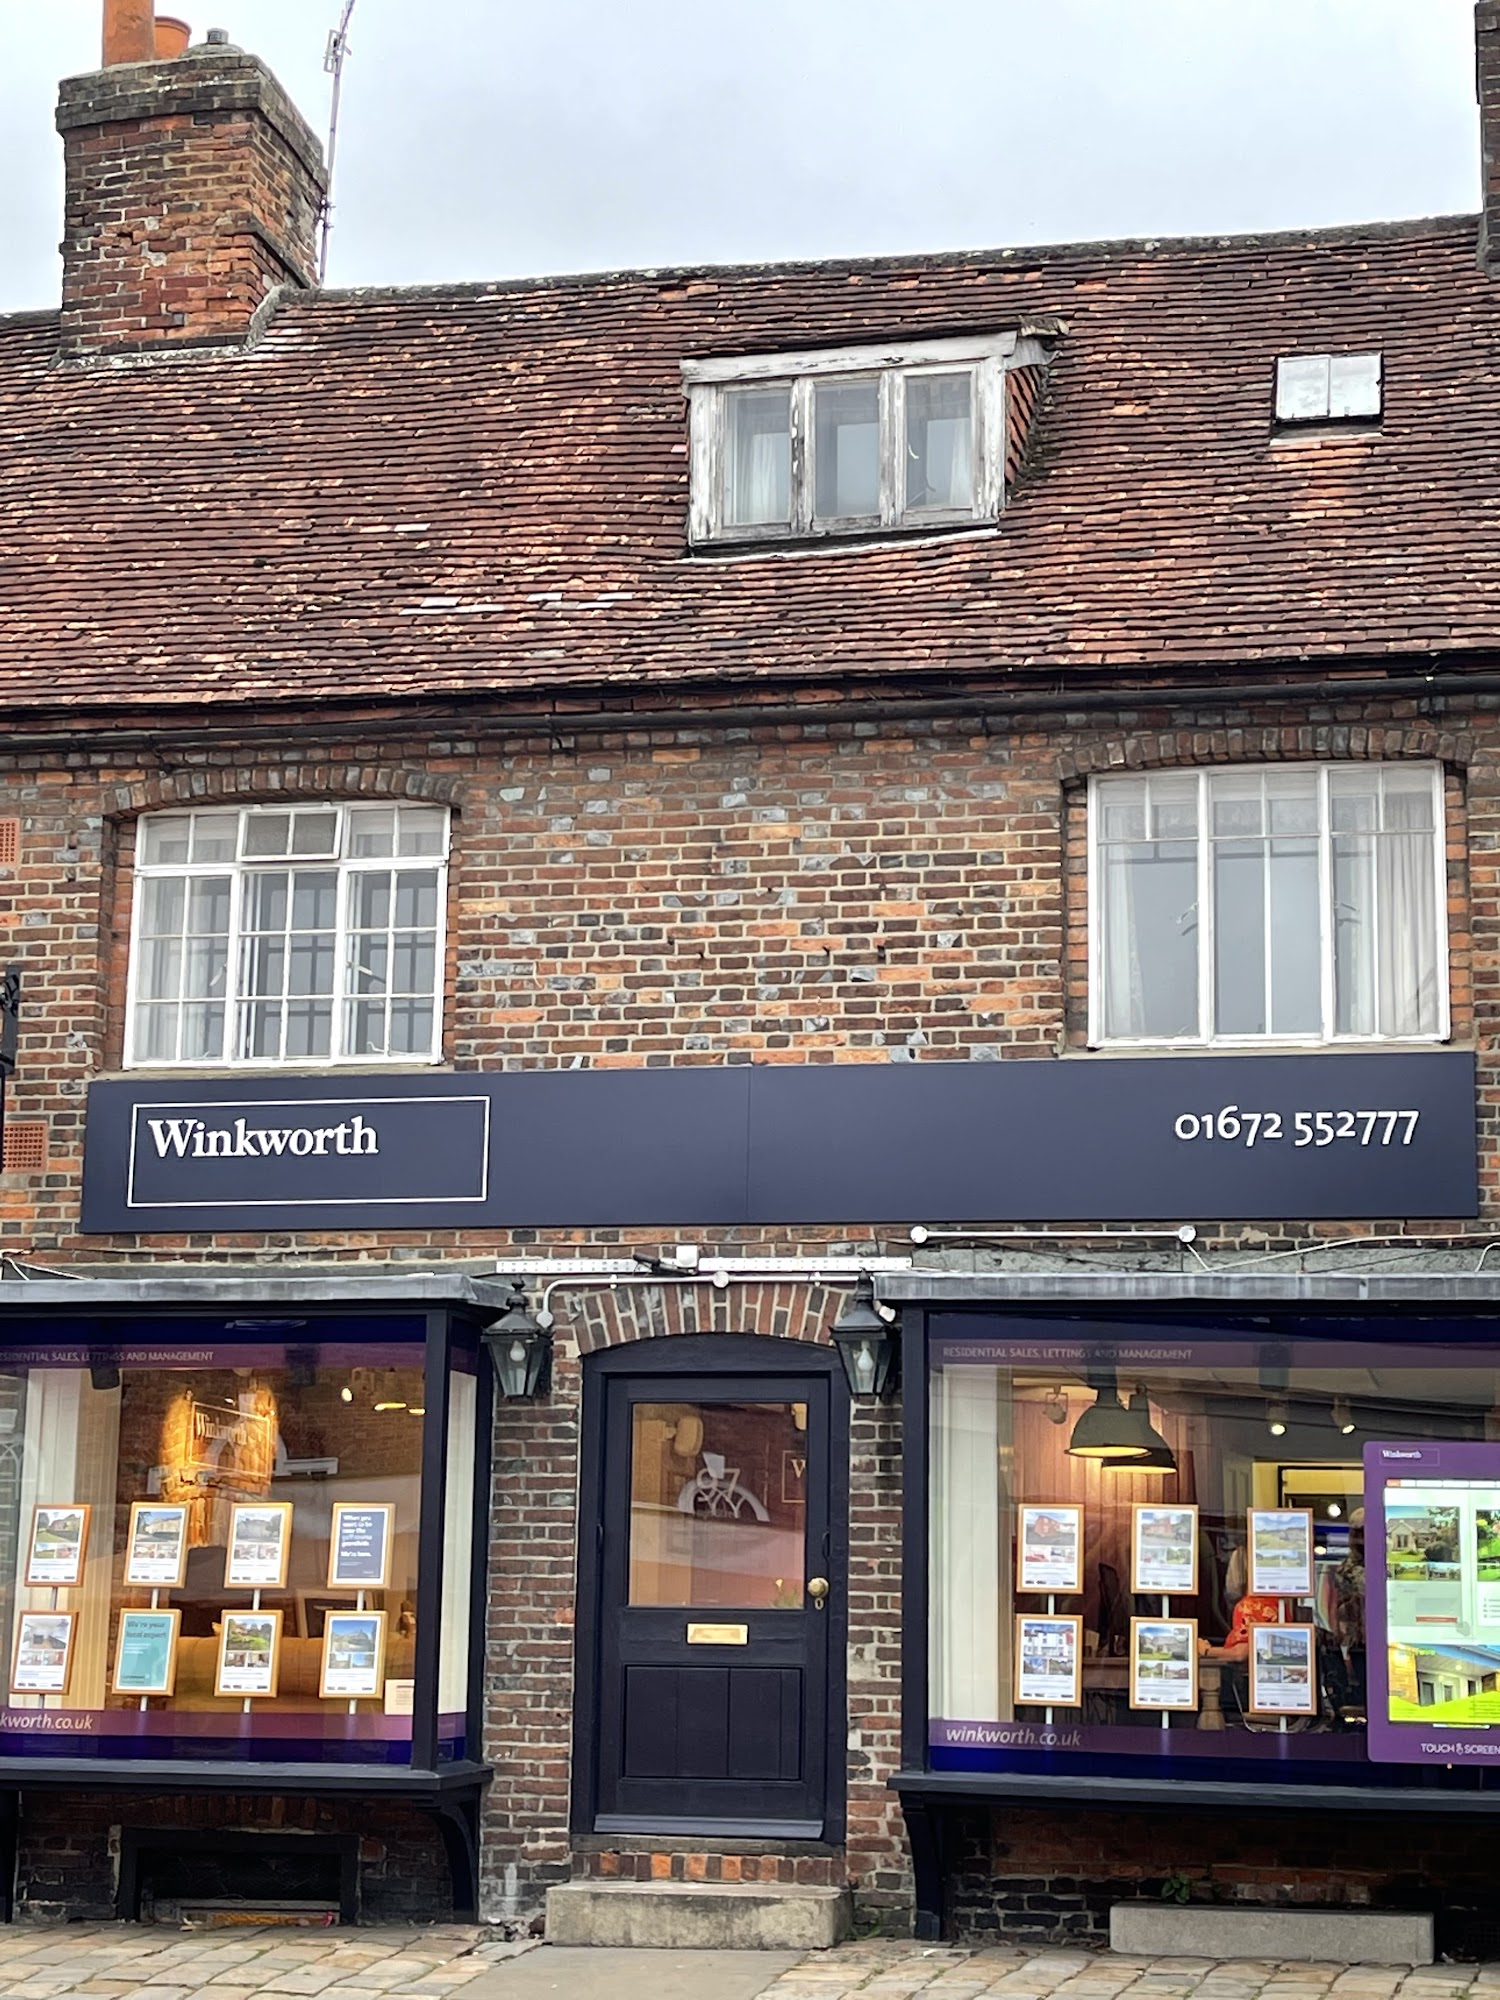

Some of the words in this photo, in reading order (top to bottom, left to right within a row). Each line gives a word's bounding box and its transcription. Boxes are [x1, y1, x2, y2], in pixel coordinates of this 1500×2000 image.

[1174, 1104, 1284, 1147] 01672
[1294, 1109, 1420, 1147] 552777
[148, 1115, 379, 1158] Winkworth
[126, 1351, 147, 1361] AND
[148, 1351, 215, 1362] MANAGEMENT
[943, 1347, 1007, 1358] RESIDENTIAL
[1118, 1349, 1193, 1360] MANAGEMENT
[0, 1712, 94, 1730] kworth.co.uk
[946, 1725, 1082, 1747] winkworth.co.uk
[1420, 1742, 1455, 1753] TOUCH
[1464, 1743, 1500, 1755] SCREEN
